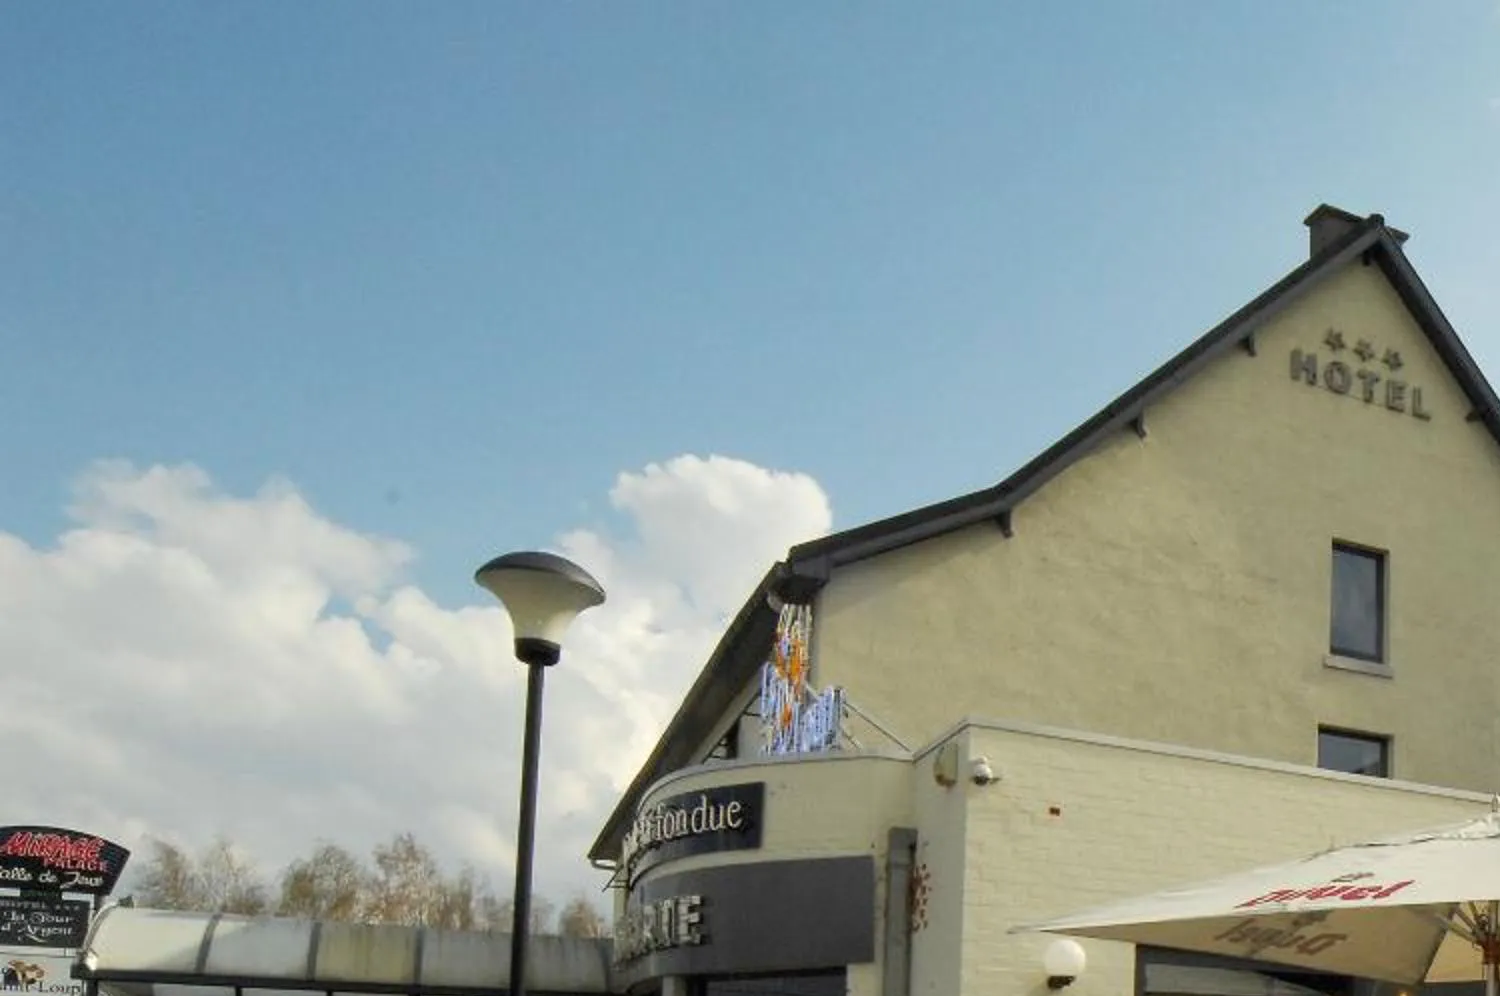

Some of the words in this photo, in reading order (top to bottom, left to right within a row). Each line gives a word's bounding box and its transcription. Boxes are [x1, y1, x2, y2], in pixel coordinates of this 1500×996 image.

[1289, 348, 1432, 422] HOTEL
[43, 857, 109, 872] PALACE
[39, 870, 58, 882] de
